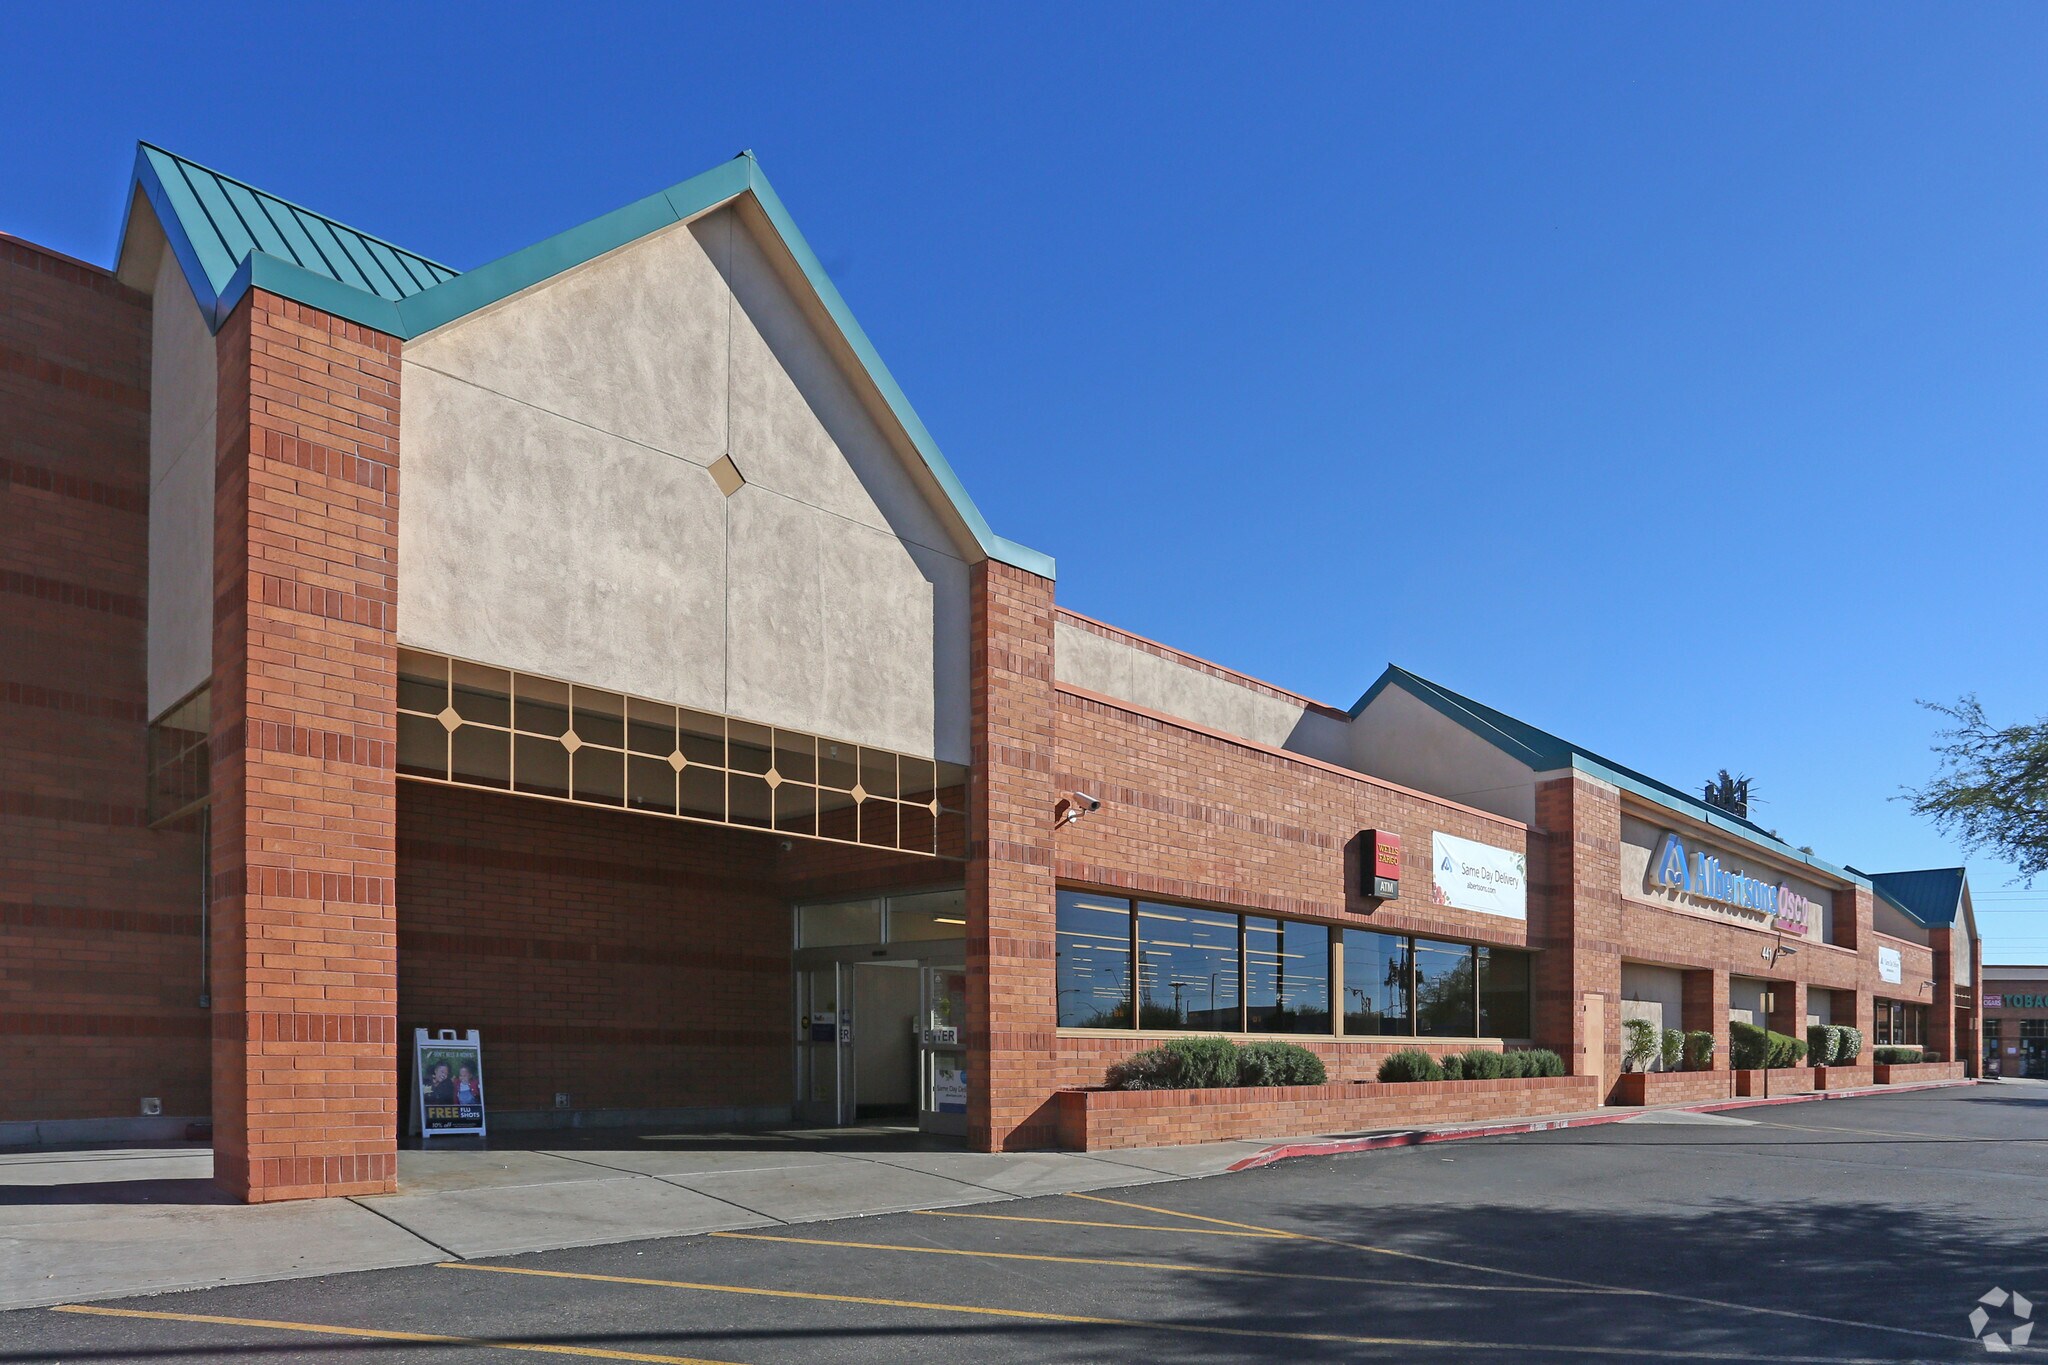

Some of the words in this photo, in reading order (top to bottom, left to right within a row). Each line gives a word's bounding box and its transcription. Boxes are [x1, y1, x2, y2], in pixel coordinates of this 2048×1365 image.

[1377, 843, 1399, 856] WELLS
[1377, 853, 1399, 866] FARGO
[1461, 862, 1480, 879] Same
[1481, 868, 1494, 884] Day
[1494, 872, 1519, 890] Delivery
[1379, 881, 1394, 893] ATM
[1466, 881, 1497, 895] albertsons.com
[1694, 851, 1778, 915] Albertsons
[1778, 881, 1809, 925] Osco
[428, 1107, 459, 1119] FREE
